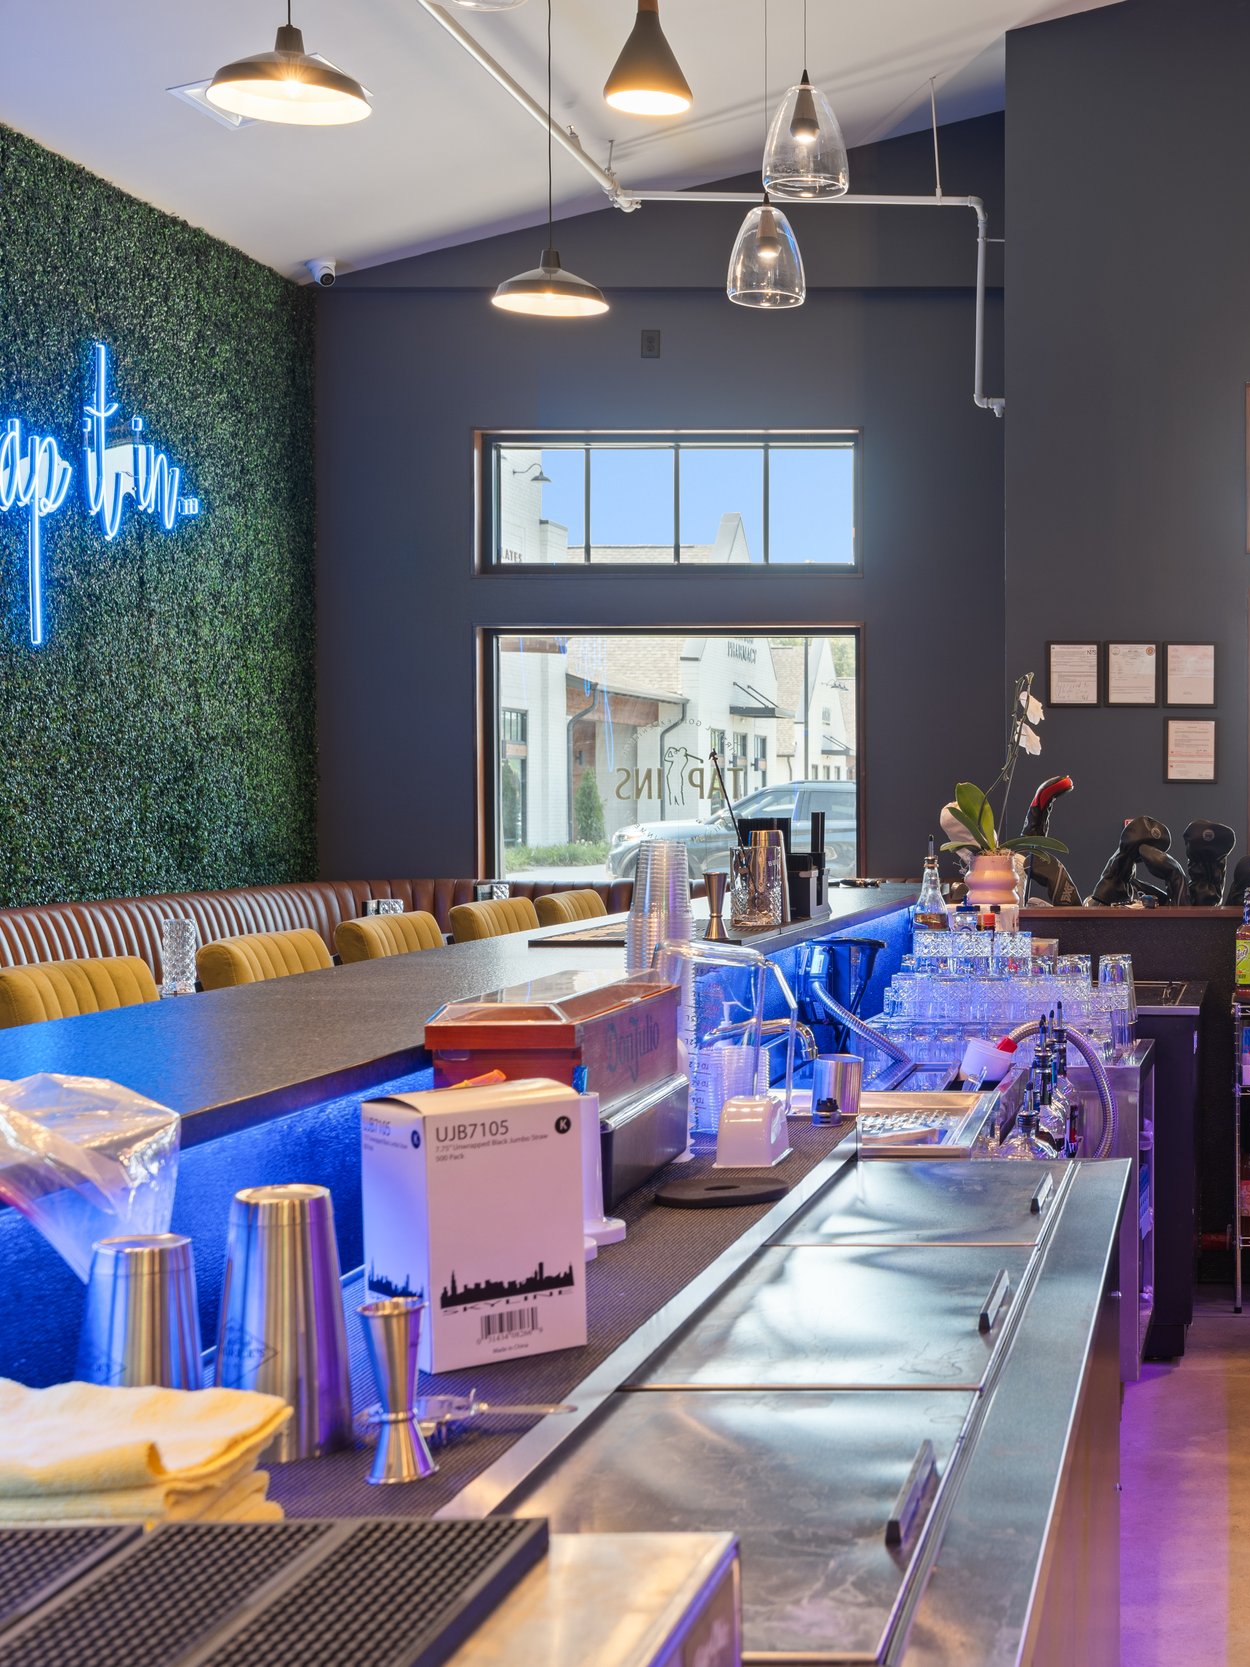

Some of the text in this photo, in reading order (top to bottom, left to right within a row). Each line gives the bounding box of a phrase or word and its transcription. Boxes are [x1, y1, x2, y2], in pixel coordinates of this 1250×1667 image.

[436, 1120, 509, 1143] UJB7105
[451, 1139, 491, 1151] Unwrapped
[492, 1138, 508, 1147] Black
[509, 1135, 530, 1145] Jumbo
[531, 1134, 548, 1142] Straw
[449, 1153, 465, 1161] Pack
[443, 1289, 574, 1315] SKYLINE
[493, 1346, 508, 1354] Made
[513, 1343, 529, 1351] China
